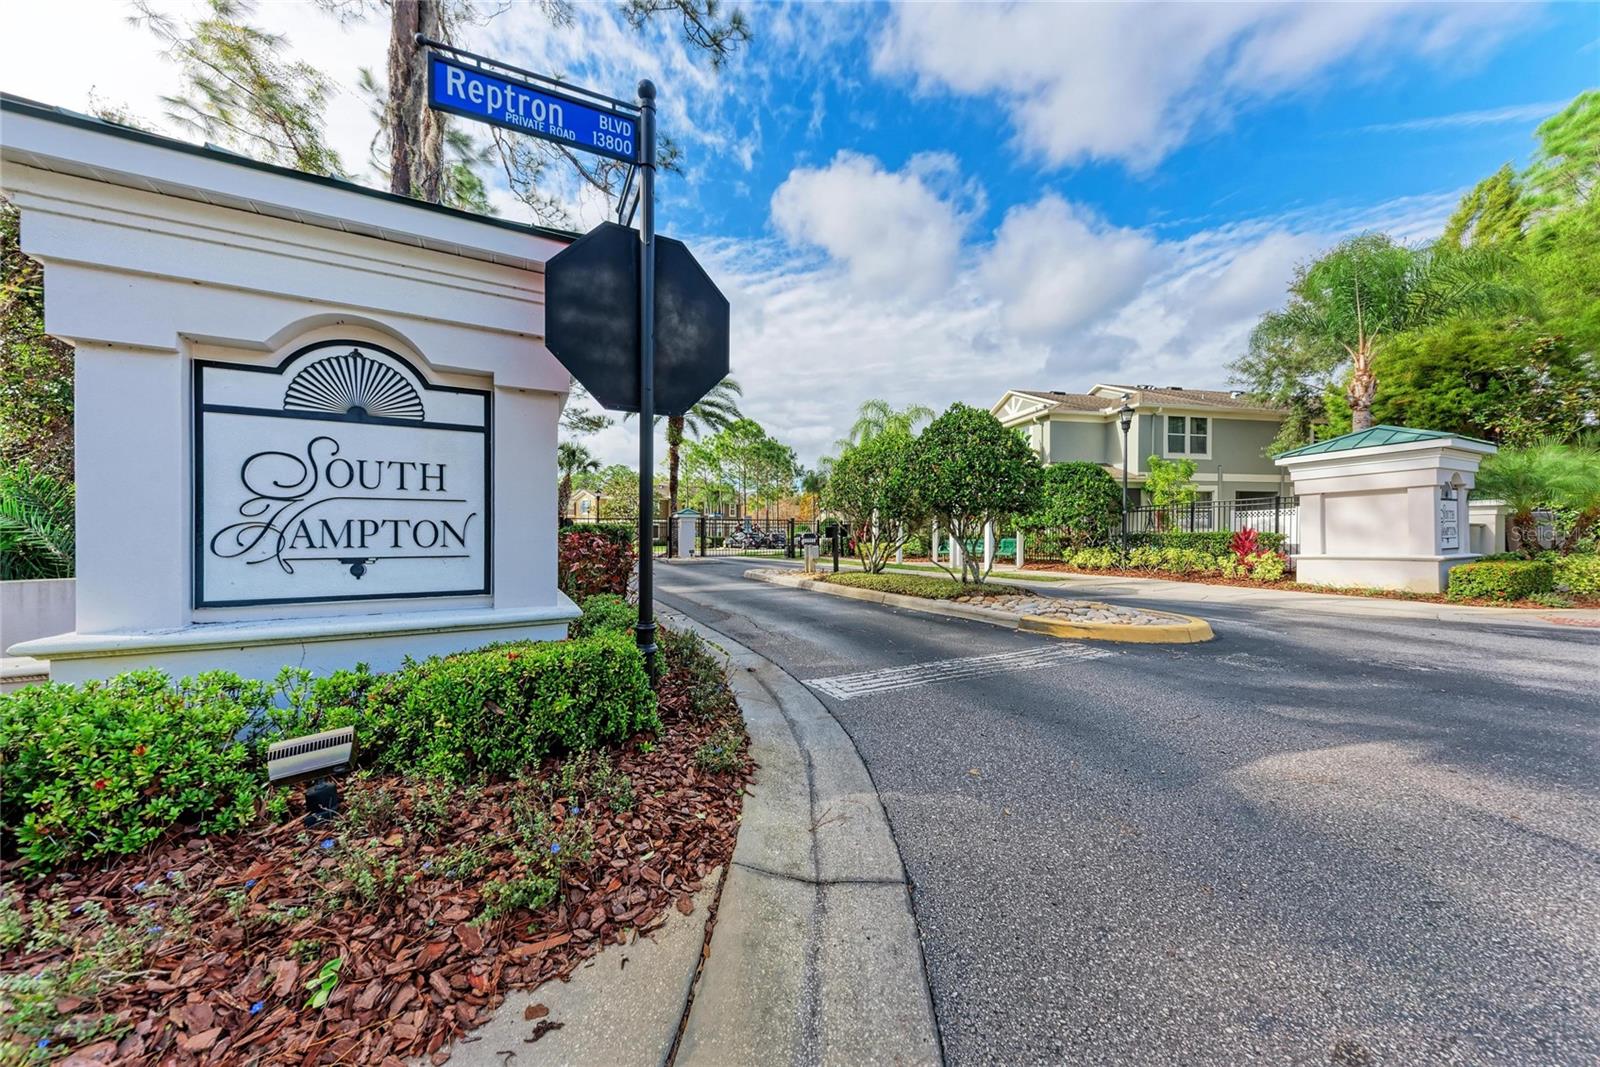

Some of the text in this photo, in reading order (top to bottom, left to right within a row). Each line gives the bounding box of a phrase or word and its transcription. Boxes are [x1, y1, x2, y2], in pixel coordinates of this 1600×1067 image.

[446, 65, 564, 128] Reptron
[504, 111, 576, 142] PRIVATE ROAD
[592, 131, 632, 155] 13800
[599, 114, 631, 137] BLVD
[240, 436, 448, 500] SOUTH
[210, 497, 478, 575] HAMPTON
